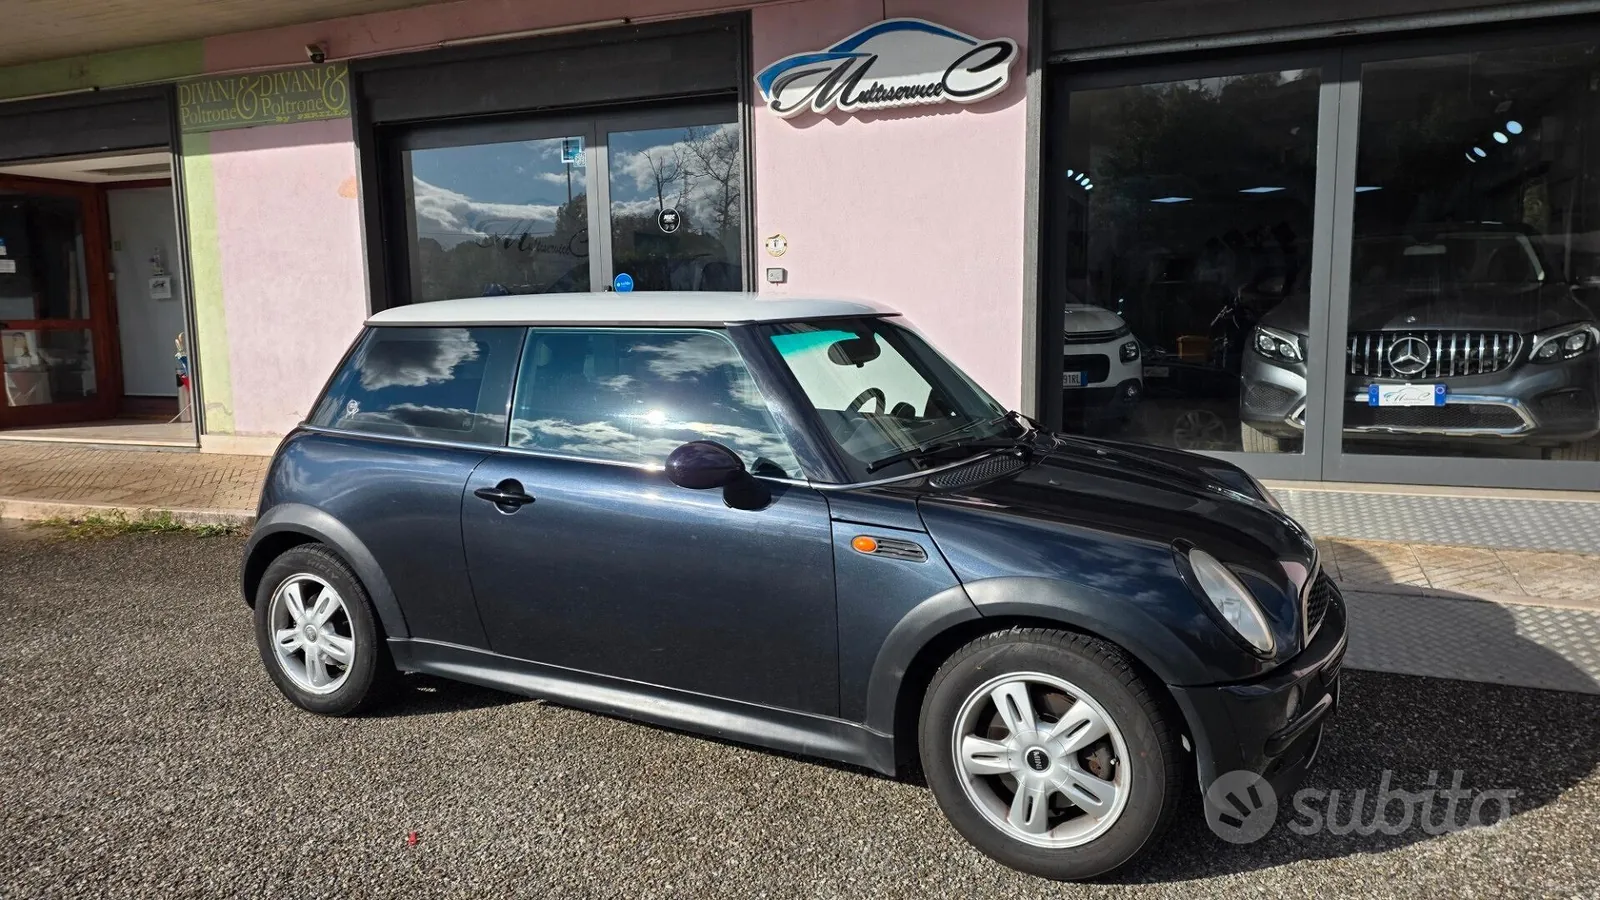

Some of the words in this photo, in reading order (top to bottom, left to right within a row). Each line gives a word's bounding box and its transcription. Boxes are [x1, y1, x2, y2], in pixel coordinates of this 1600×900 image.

[179, 79, 237, 108] DIVANI
[260, 68, 322, 97] DIVANI
[180, 105, 237, 126] Poltrone
[261, 98, 323, 117] Poltrone
[1032, 751, 1043, 769] MINI
